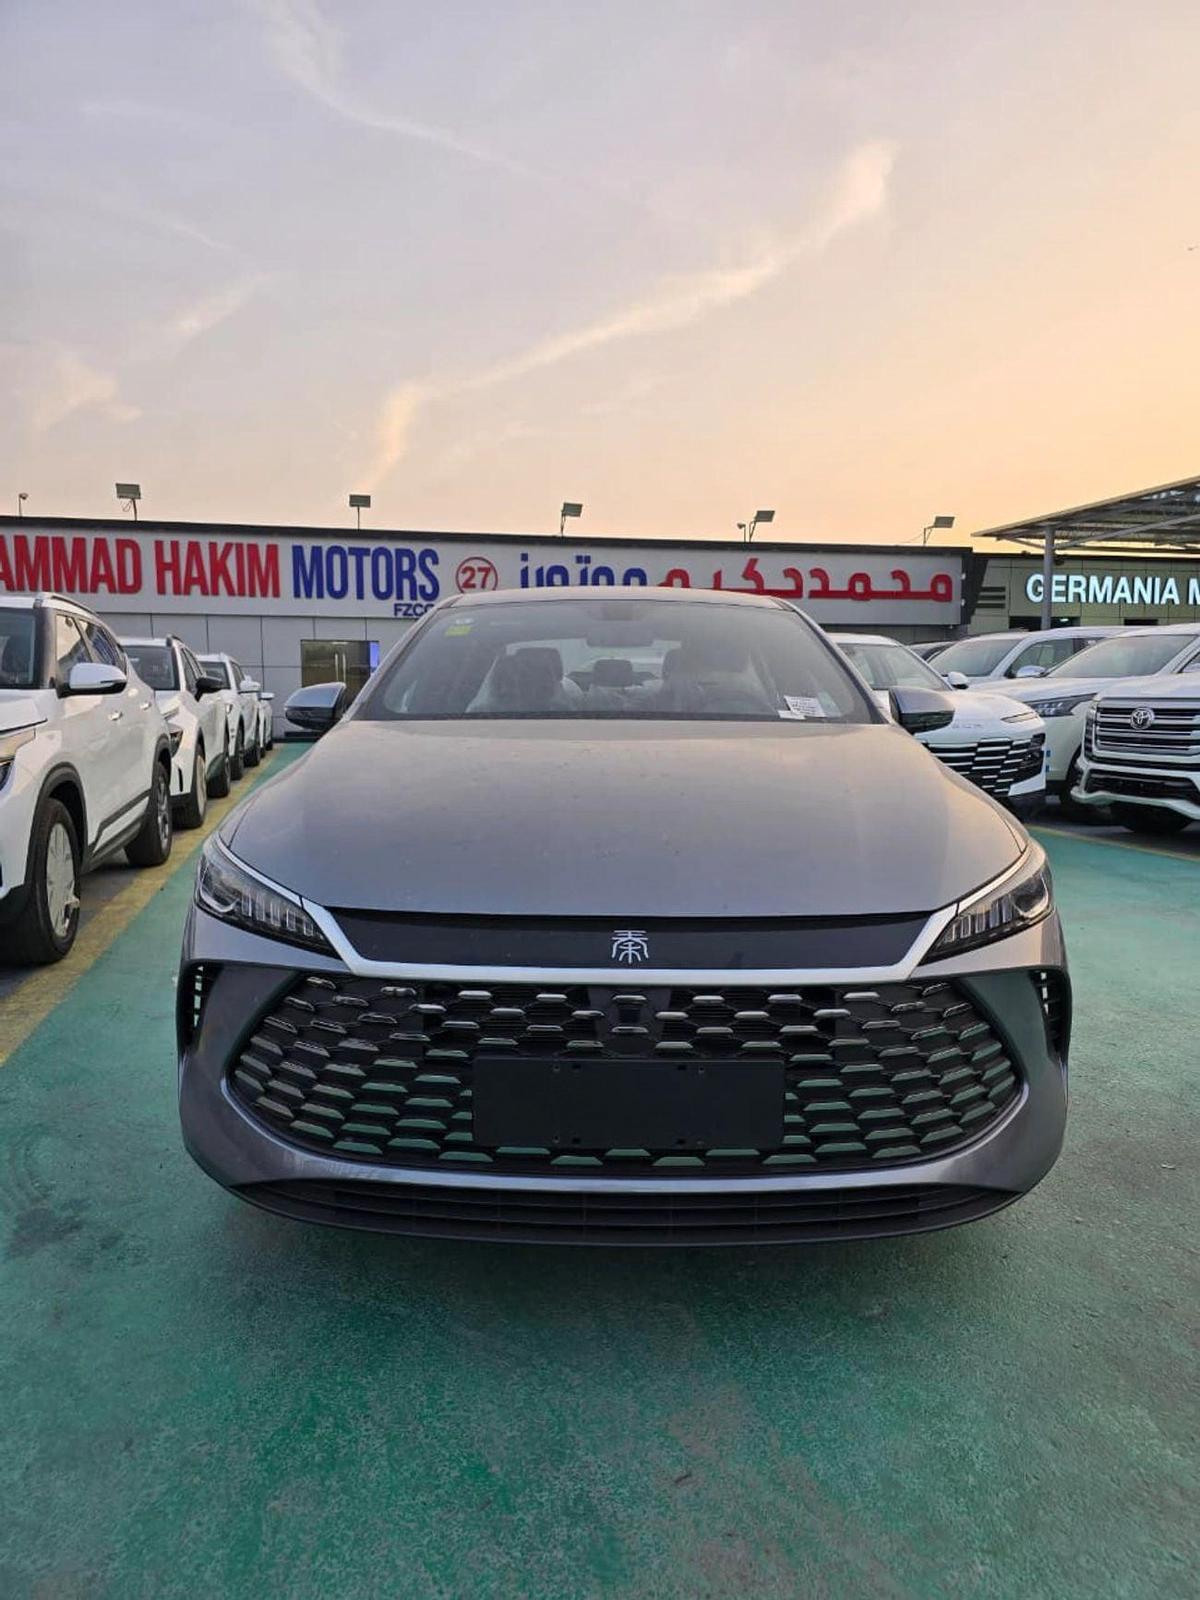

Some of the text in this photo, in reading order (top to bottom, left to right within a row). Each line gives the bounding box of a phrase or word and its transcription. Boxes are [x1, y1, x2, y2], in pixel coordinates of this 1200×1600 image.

[154, 539, 280, 598] HAKIM
[292, 545, 440, 601] MOTORS
[461, 566, 491, 589] 27
[808, 567, 953, 602] محمد
[1026, 573, 1180, 605] GERMANIA
